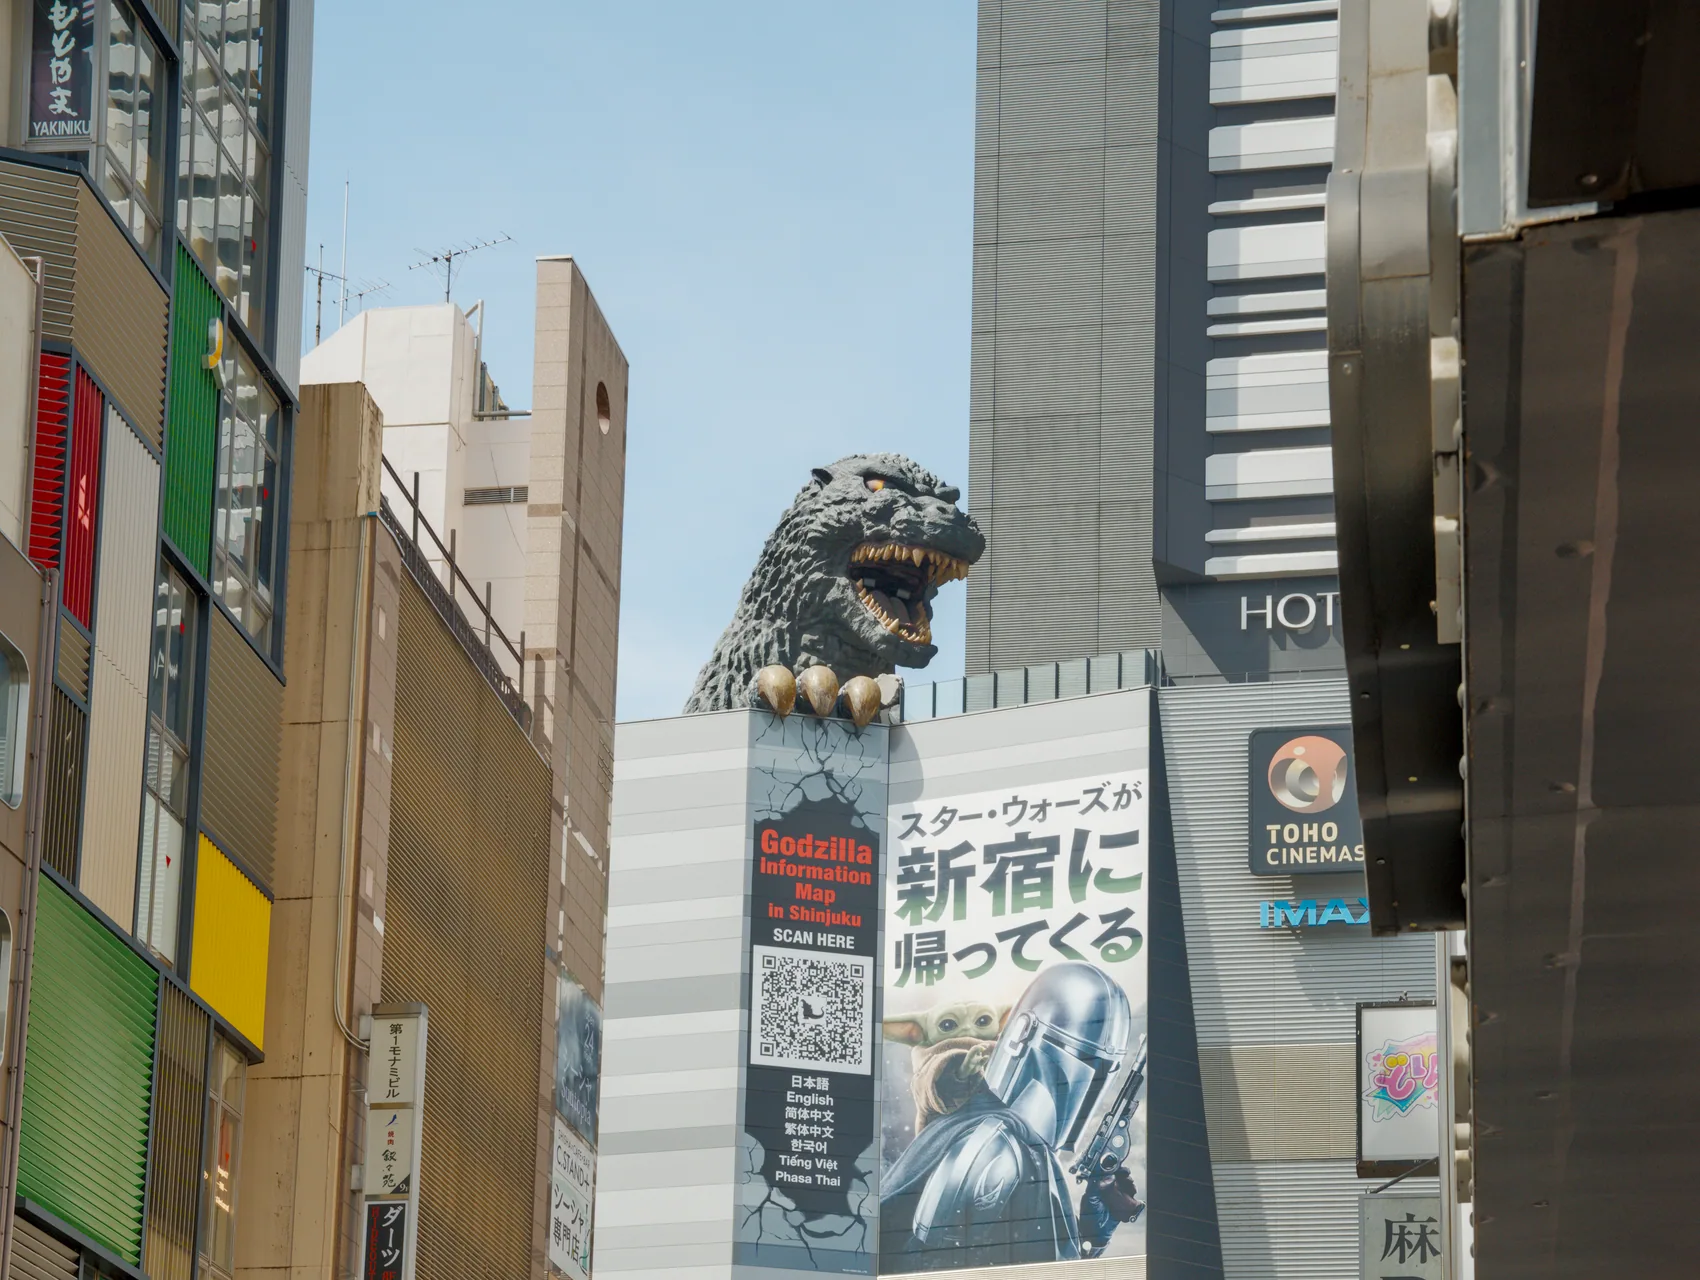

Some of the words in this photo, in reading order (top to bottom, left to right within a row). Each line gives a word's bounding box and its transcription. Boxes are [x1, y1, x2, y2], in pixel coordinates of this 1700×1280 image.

[33, 119, 91, 135] YAKINIKU
[897, 780, 1142, 841] スター・ウォーズが
[1266, 822, 1338, 844] TOHO
[760, 827, 873, 866] Godzilla
[1266, 844, 1365, 865] CINEMAS
[760, 855, 872, 887] Information
[894, 828, 1143, 926] 新宿に
[795, 880, 836, 906] Map
[768, 902, 785, 920] in
[789, 904, 862, 928] Shinjuku
[1259, 897, 1370, 929] IMAX
[773, 927, 812, 946] SCAN
[817, 931, 855, 950] HERE
[893, 907, 1143, 988] 帰ってくる
[386, 1023, 404, 1099] 第1モナミビル
[791, 1074, 830, 1092] 日本語
[786, 1090, 834, 1108] English
[785, 1105, 835, 1123] 简体中文
[387, 1130, 395, 1145] 焼肉
[790, 1137, 828, 1155] 한국어
[778, 1153, 811, 1172] Tiếng
[814, 1156, 839, 1172] Việt
[775, 1170, 812, 1187] Phasa
[814, 1172, 841, 1187] Thai
[381, 1206, 404, 1268] ダーツ
